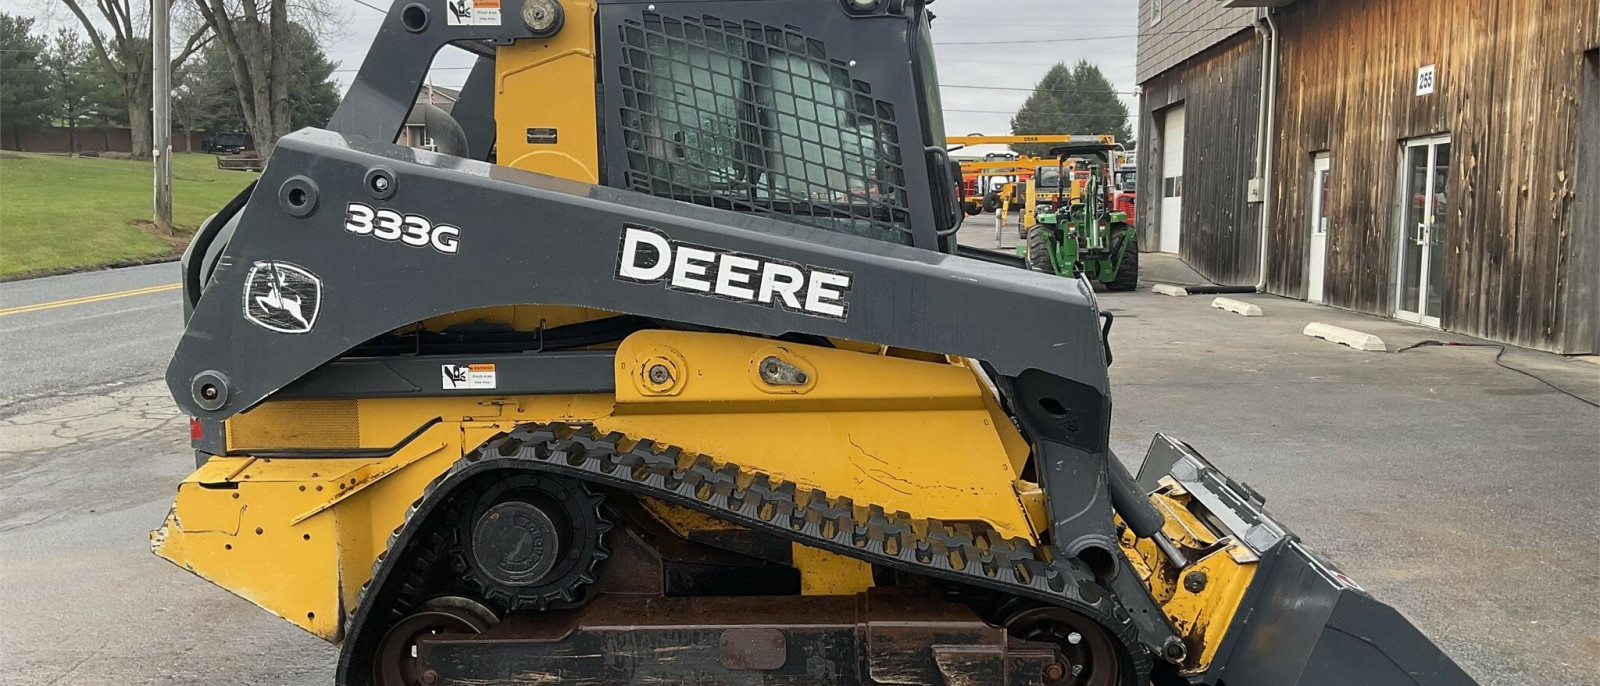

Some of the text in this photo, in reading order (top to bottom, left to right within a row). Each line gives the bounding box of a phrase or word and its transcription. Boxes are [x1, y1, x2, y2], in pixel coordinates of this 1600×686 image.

[1419, 71, 1432, 89] 255
[345, 203, 460, 254] 333G
[618, 226, 851, 318] DEERE
